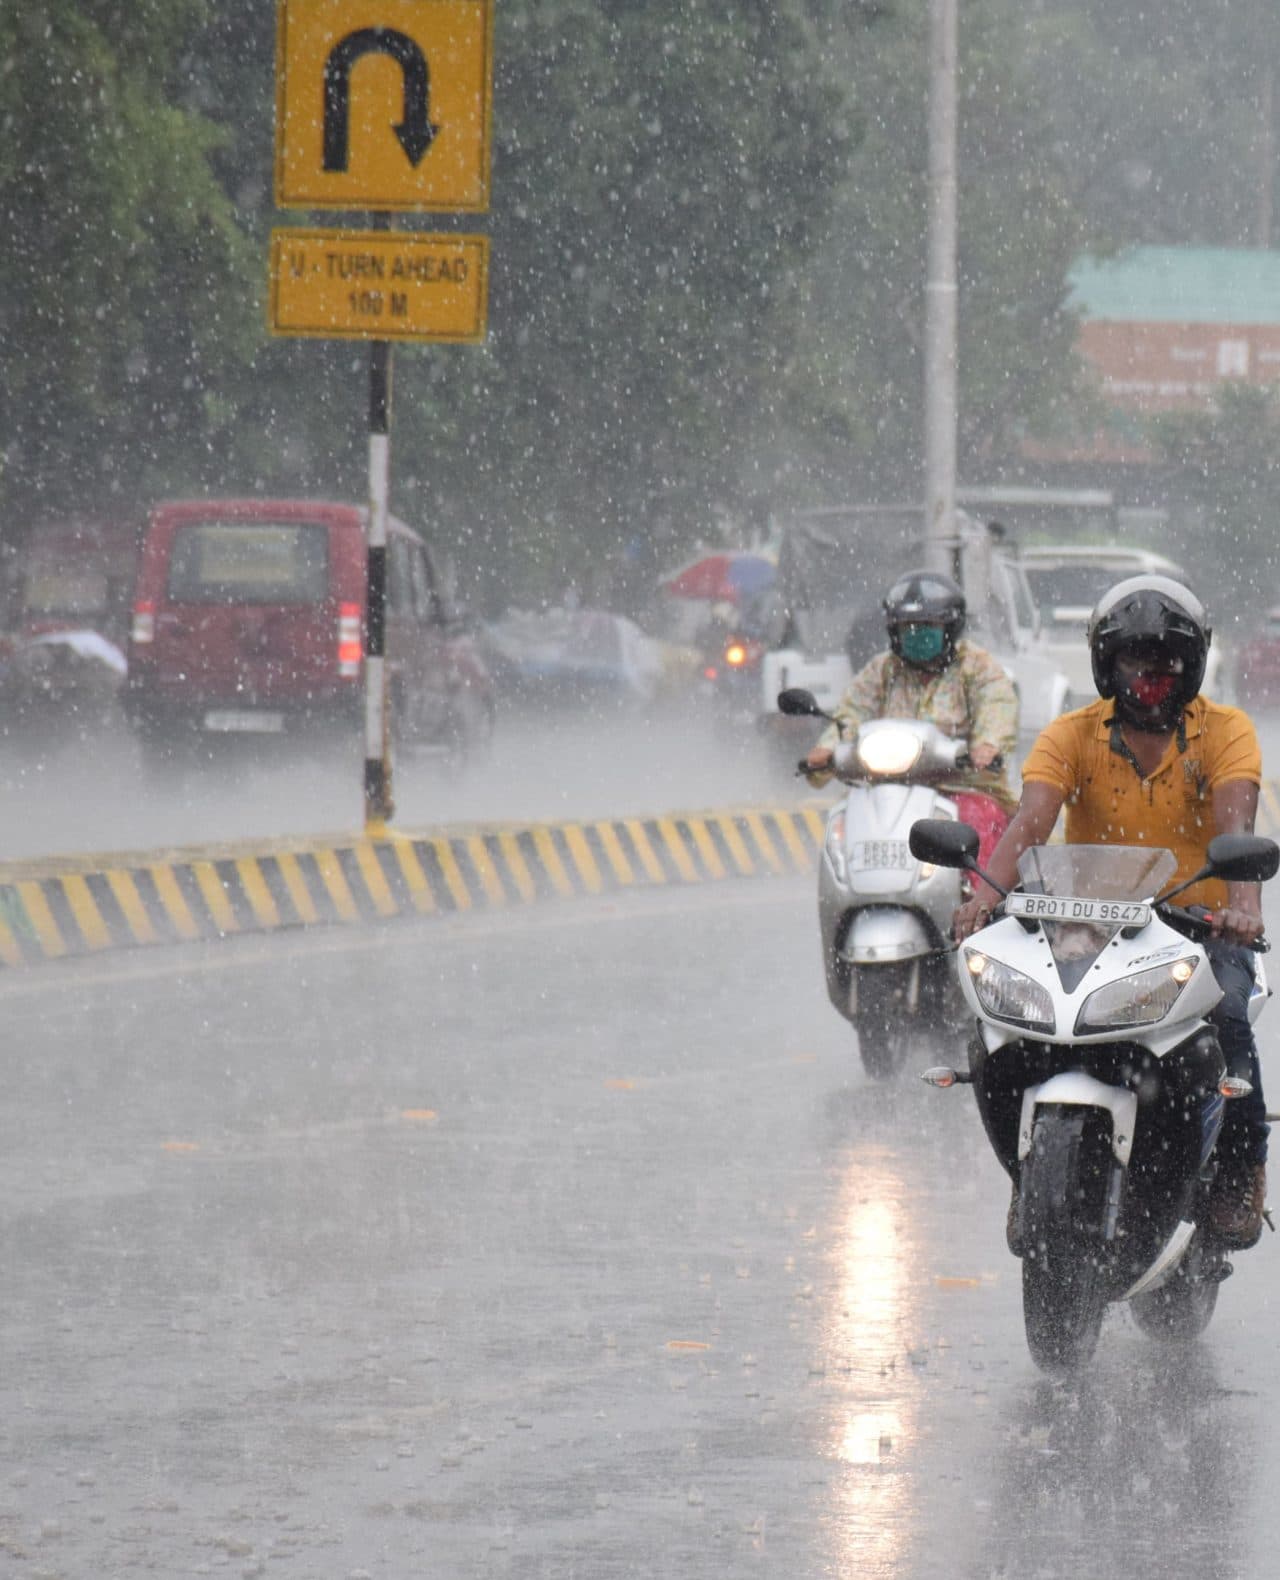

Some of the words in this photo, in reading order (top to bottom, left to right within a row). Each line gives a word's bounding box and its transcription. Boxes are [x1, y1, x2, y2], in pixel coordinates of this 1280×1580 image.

[290, 252, 306, 278] U
[326, 252, 385, 280] TURN
[391, 256, 468, 283] AHEAD
[391, 293, 408, 316] M
[1072, 903, 1094, 917] DU
[1100, 905, 1141, 920] 9647
